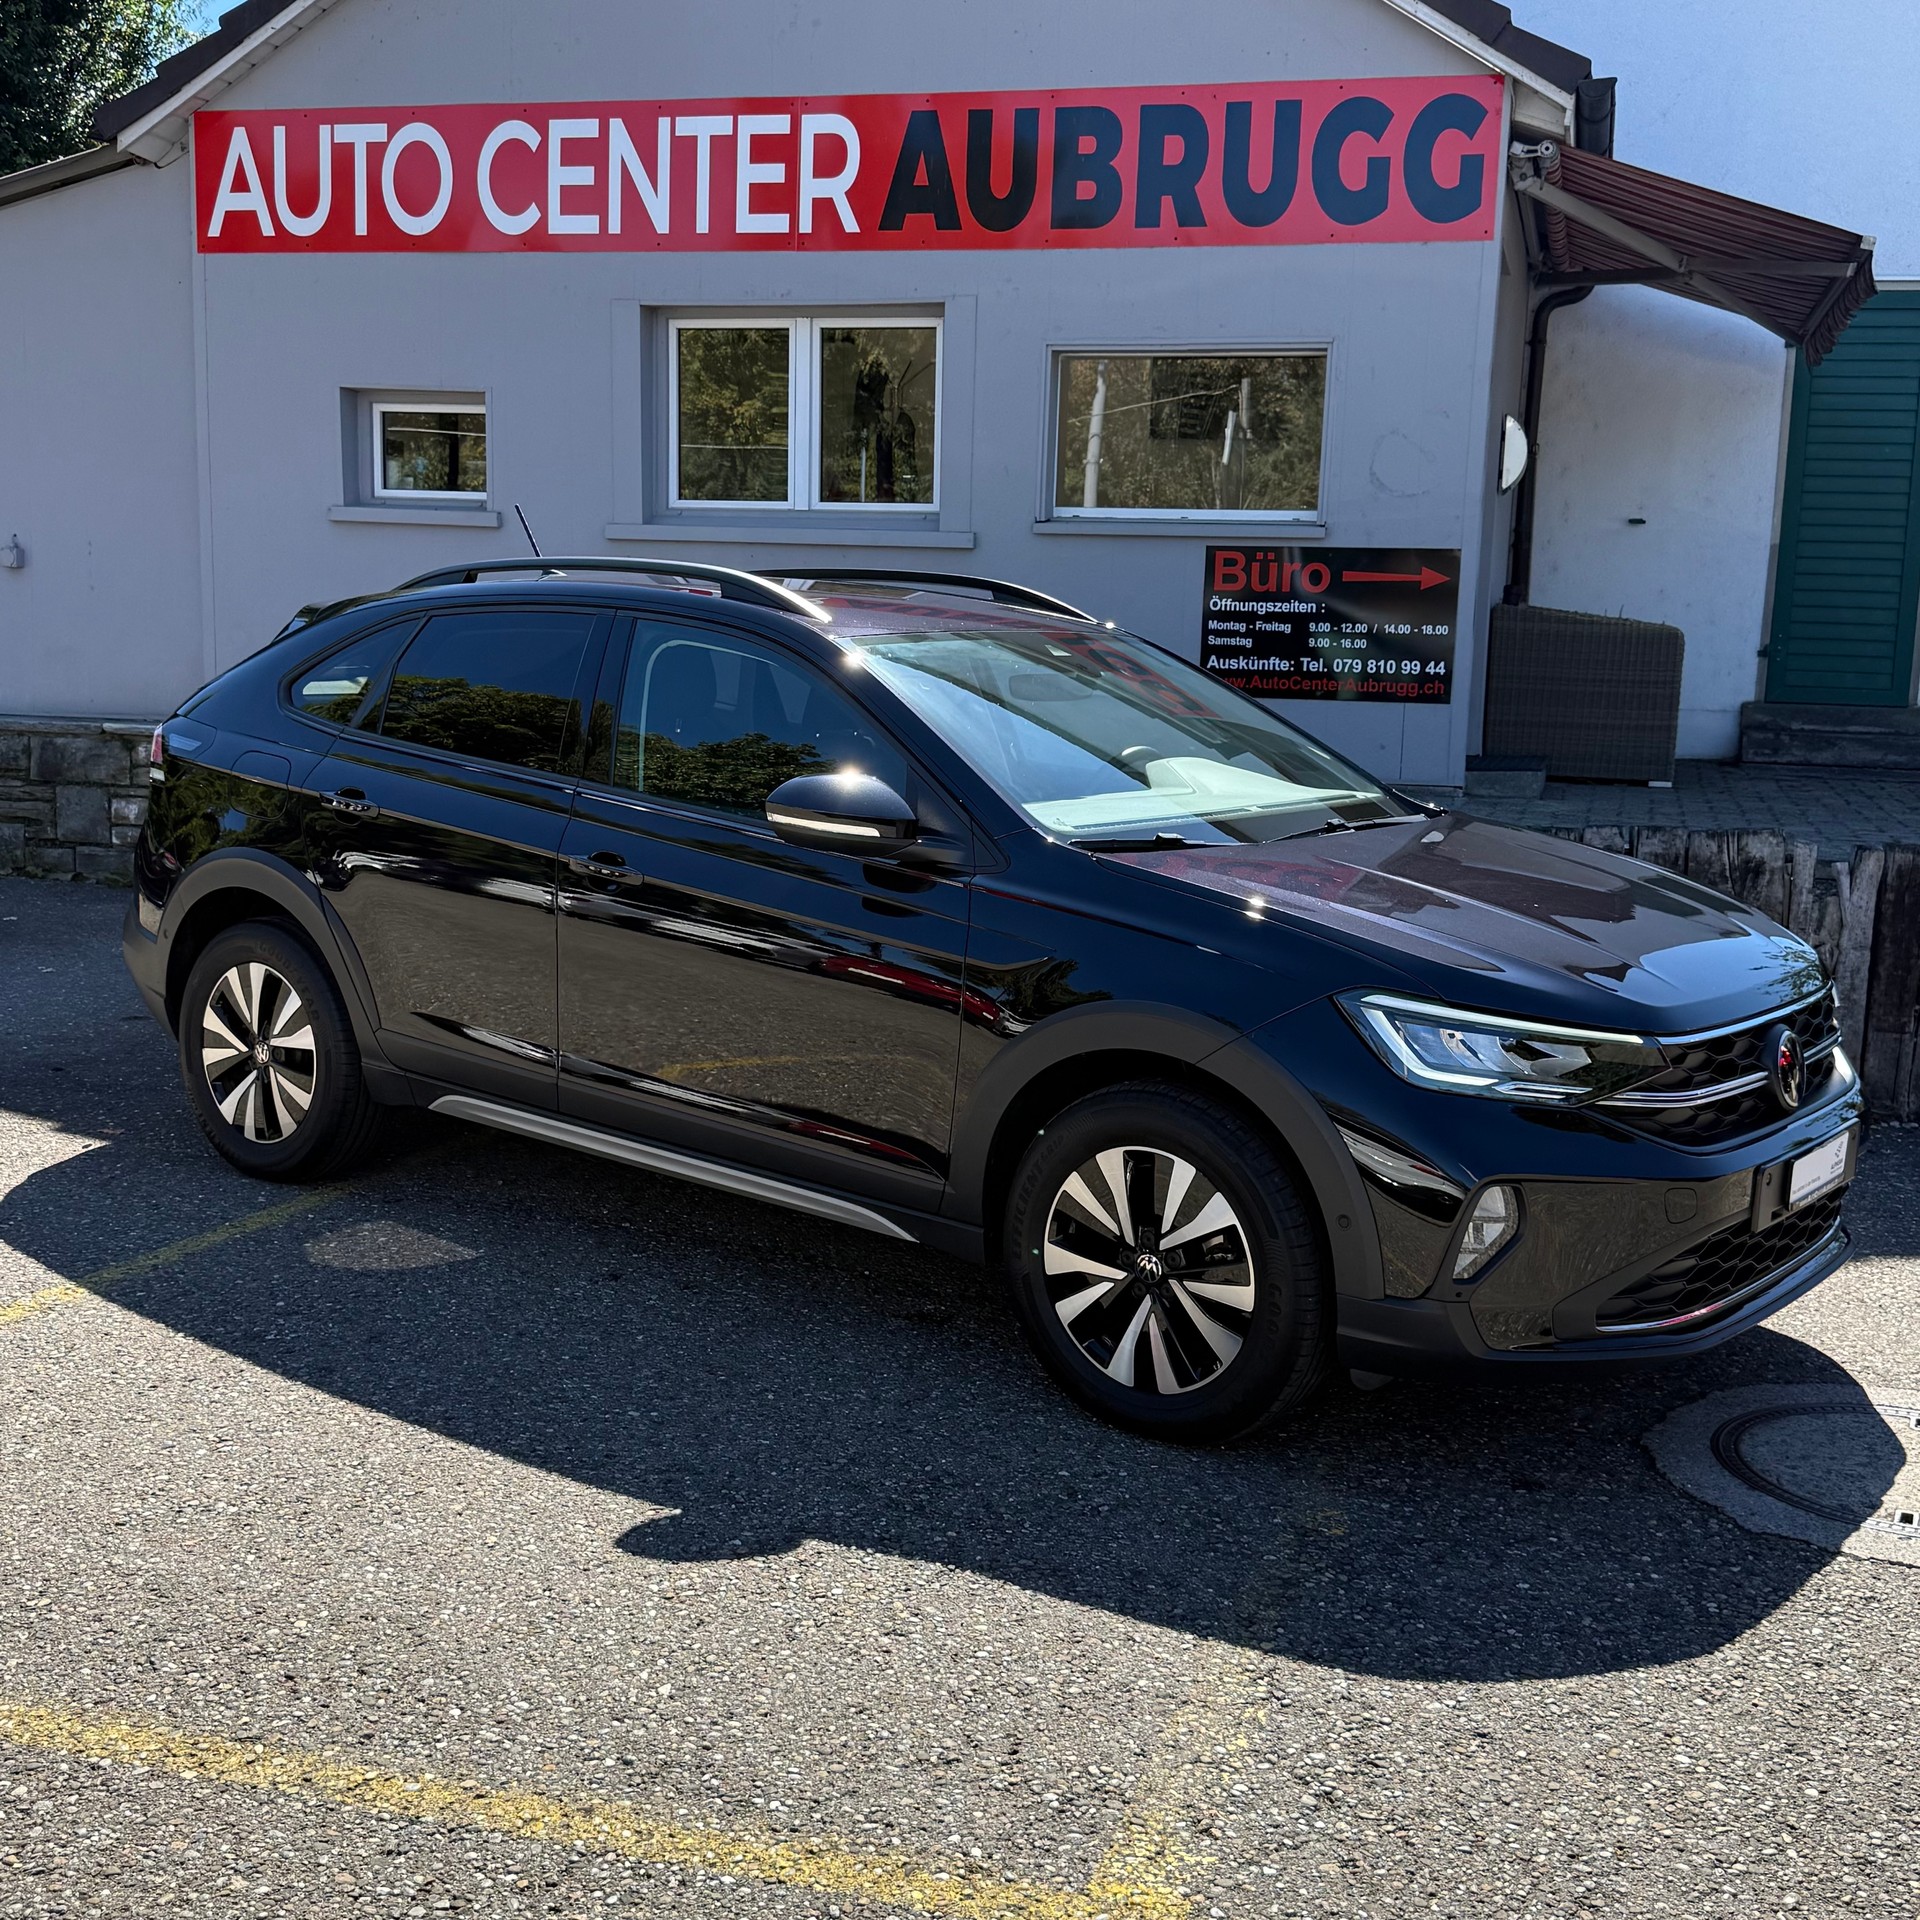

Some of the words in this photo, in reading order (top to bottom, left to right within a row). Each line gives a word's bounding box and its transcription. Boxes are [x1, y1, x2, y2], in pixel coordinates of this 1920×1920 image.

[207, 121, 454, 238] AUTO
[477, 113, 861, 236] CENTER
[878, 93, 1489, 232] AUBRUGG
[1213, 550, 1331, 593] Büro
[1209, 595, 1317, 615] Öffnungszeiten
[1208, 620, 1247, 633] Montag
[1255, 621, 1292, 634] Freitag
[1308, 622, 1331, 633] 9.00
[1340, 623, 1368, 634] 12.00
[1383, 624, 1411, 635] 14.00
[1421, 625, 1449, 635] 18.00
[1207, 635, 1253, 648] Samstag
[1308, 638, 1330, 648] 9.00
[1340, 639, 1367, 649] 16.00
[1206, 655, 1295, 671] Auskünfte:
[1300, 657, 1328, 672] Tel.
[1333, 659, 1362, 673] 079
[1366, 660, 1396, 674] 810
[1401, 660, 1421, 675] 99
[1425, 661, 1446, 676] 44
[1224, 675, 1445, 697] w.AutoCenterAubrugg.ch
